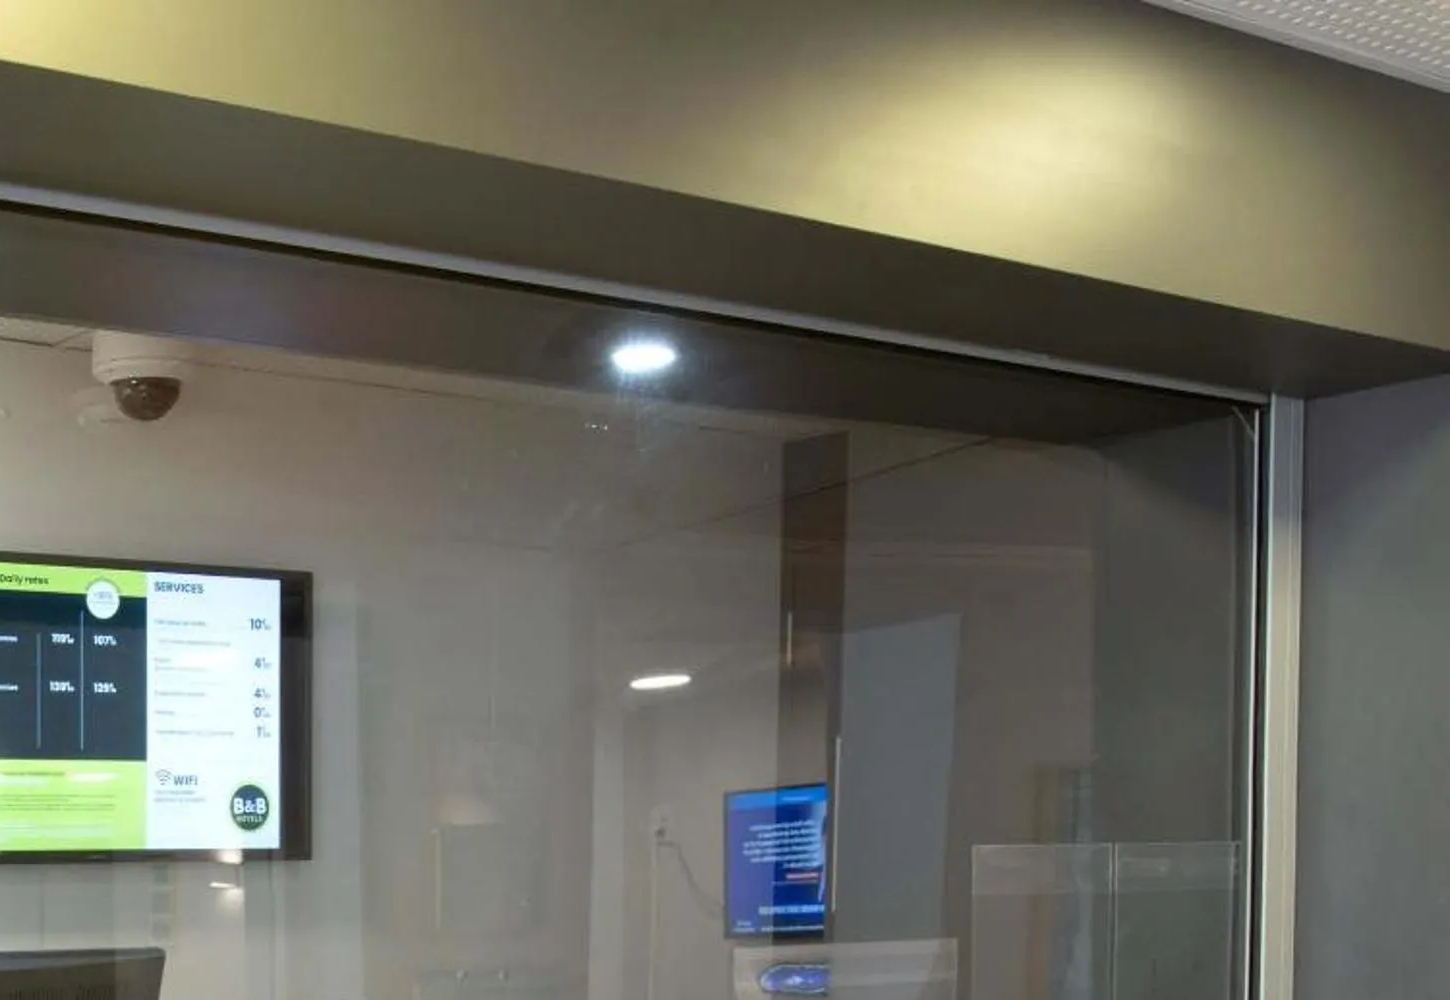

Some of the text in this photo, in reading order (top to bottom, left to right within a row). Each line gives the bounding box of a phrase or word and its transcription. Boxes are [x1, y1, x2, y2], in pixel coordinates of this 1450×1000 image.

[0, 573, 23, 585] Daily
[154, 581, 205, 594] SERVICES
[233, 797, 267, 815] B&B
